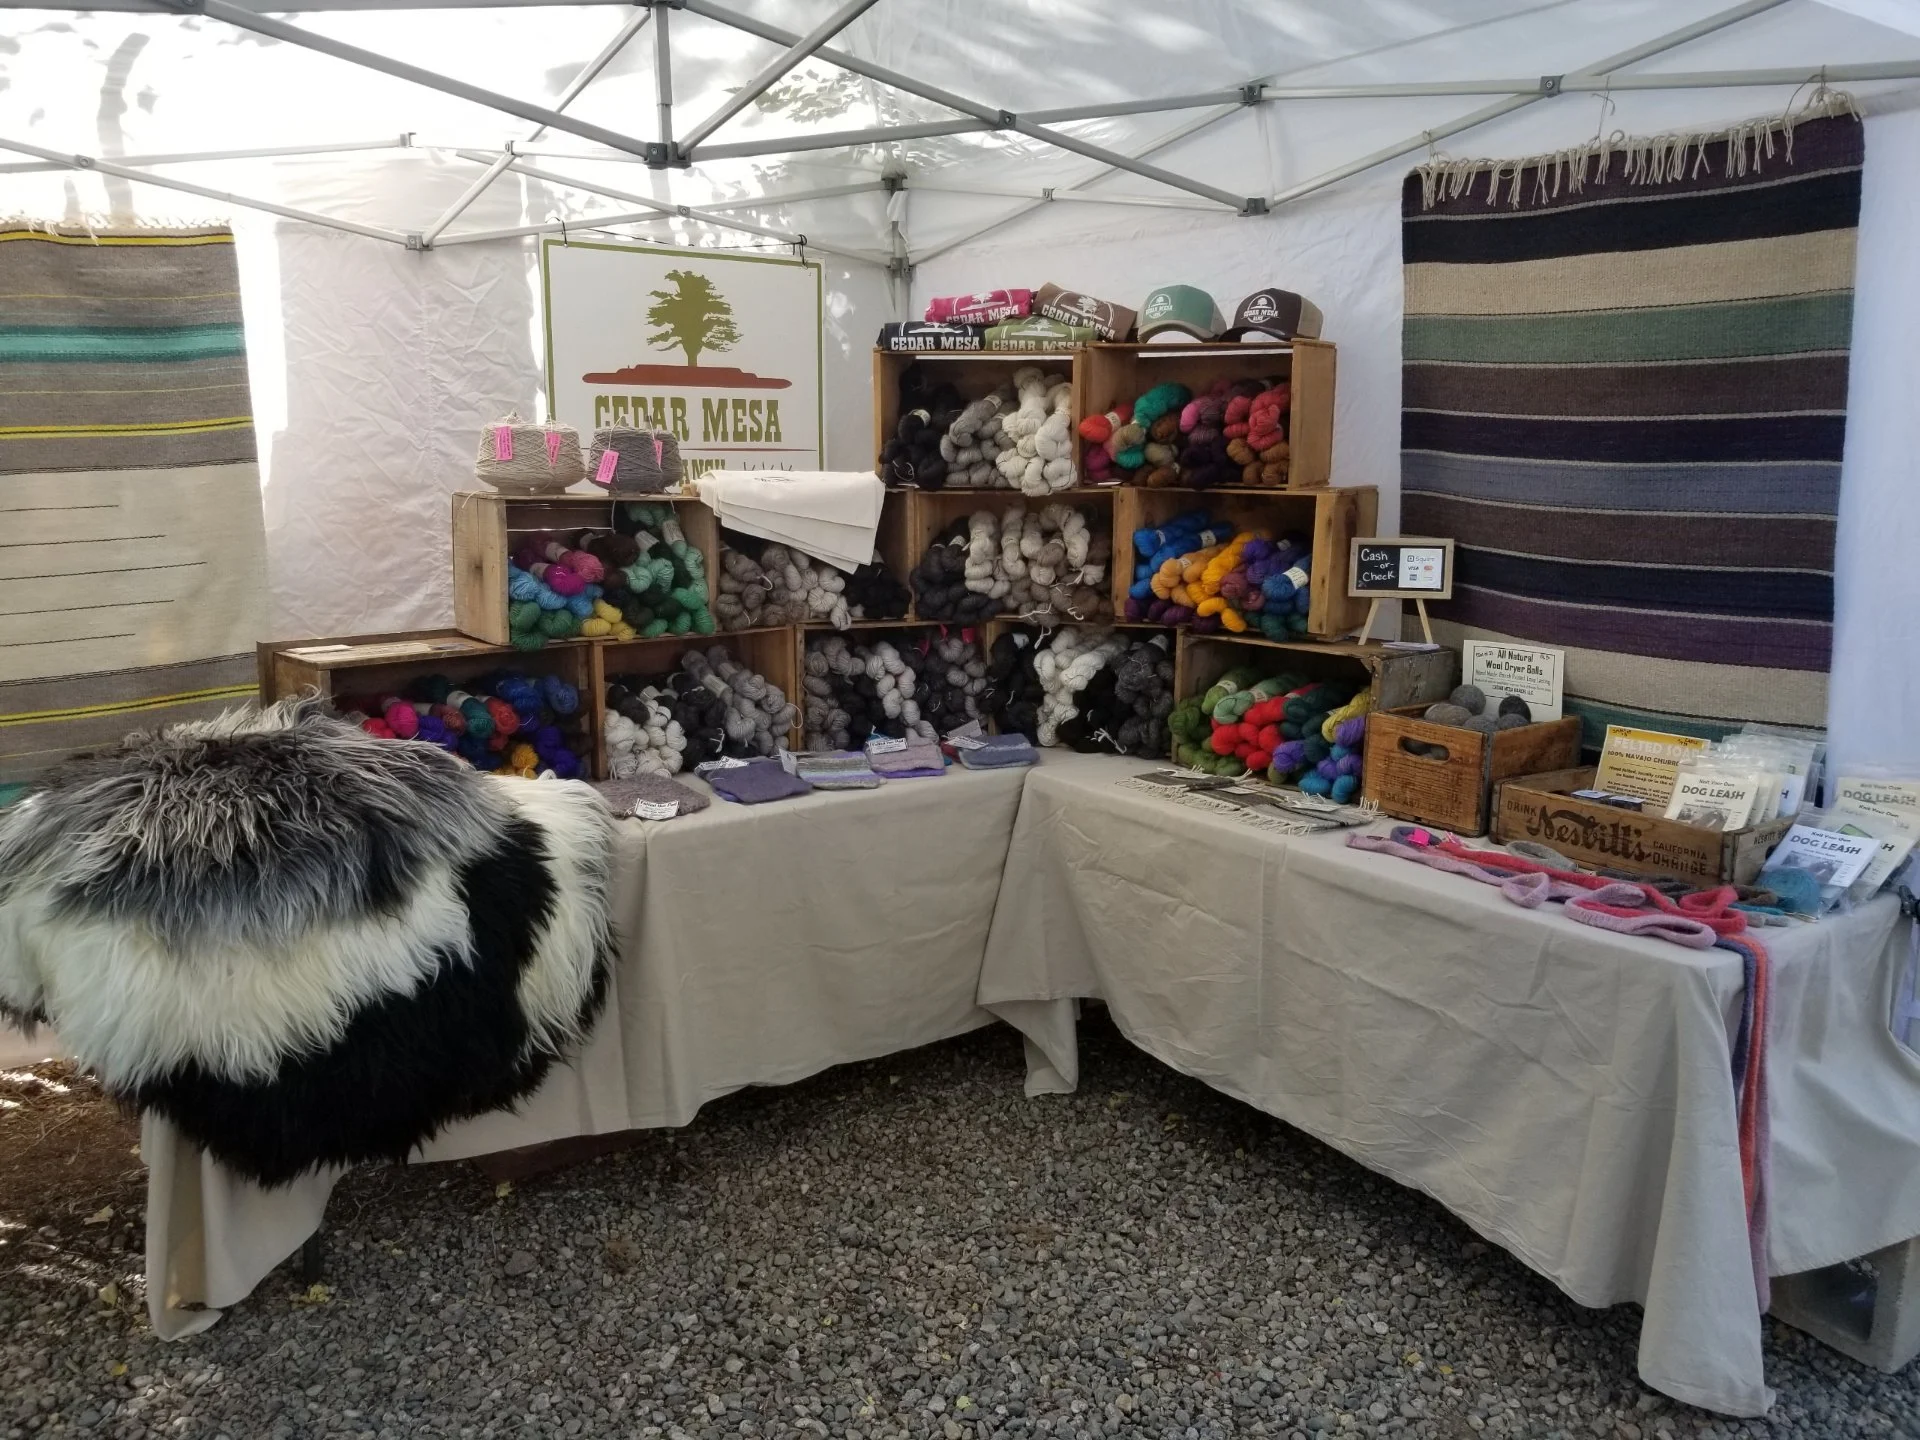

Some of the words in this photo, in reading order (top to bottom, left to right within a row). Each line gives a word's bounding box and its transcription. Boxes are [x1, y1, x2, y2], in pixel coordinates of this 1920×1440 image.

[946, 311, 985, 324] CEDAR
[988, 304, 1020, 320] MESA
[1041, 303, 1077, 327] CEDAR
[1082, 317, 1116, 340] MESA
[891, 336, 940, 351] CEDAR
[940, 336, 980, 350] MESA
[992, 340, 1036, 352] CEDAR
[595, 394, 690, 442] CEDAR
[702, 397, 782, 442] MESA
[1361, 548, 1388, 561] Cash
[1362, 571, 1395, 582] Check
[1497, 650, 1507, 659] All
[1508, 650, 1534, 662] Natural
[1486, 660, 1503, 671] Wool
[1504, 661, 1526, 674] Dryer
[1526, 664, 1543, 675] Balls
[1613, 736, 1663, 756] FELTED
[1607, 750, 1624, 758] 100%
[1625, 752, 1652, 762] NAVAJO
[1681, 784, 1708, 796] DOG
[1709, 788, 1746, 800] LEASH
[1843, 789, 1873, 802] DOG
[1507, 800, 1538, 817] DRINK
[1526, 804, 1648, 863] Nesbitt's
[1653, 840, 1708, 860] CALIFORNIA
[1791, 835, 1820, 847] DOG
[1821, 841, 1862, 855] LEASH
